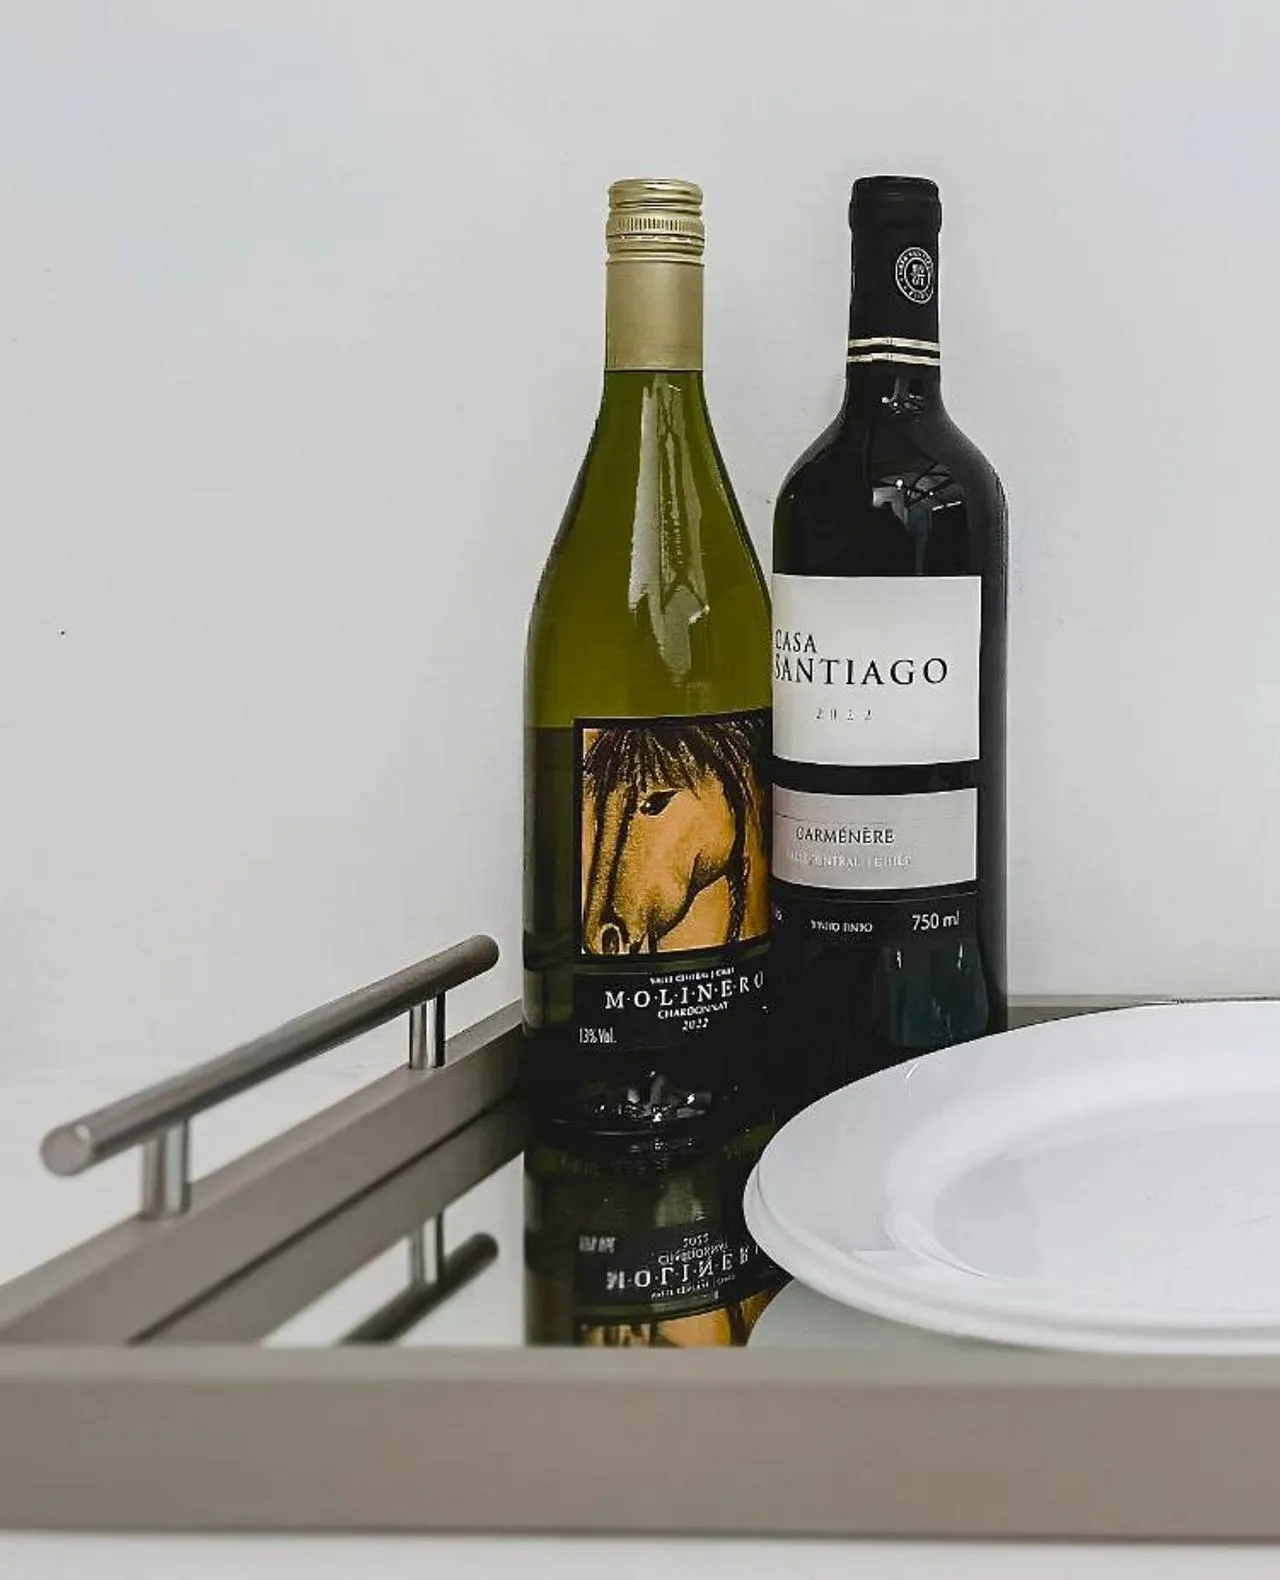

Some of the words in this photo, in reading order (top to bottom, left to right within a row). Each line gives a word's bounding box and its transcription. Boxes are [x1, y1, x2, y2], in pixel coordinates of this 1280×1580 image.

[775, 628, 817, 653] CASA
[775, 652, 948, 686] SANTIAGO
[911, 912, 939, 931] 750
[942, 910, 960, 928] ml
